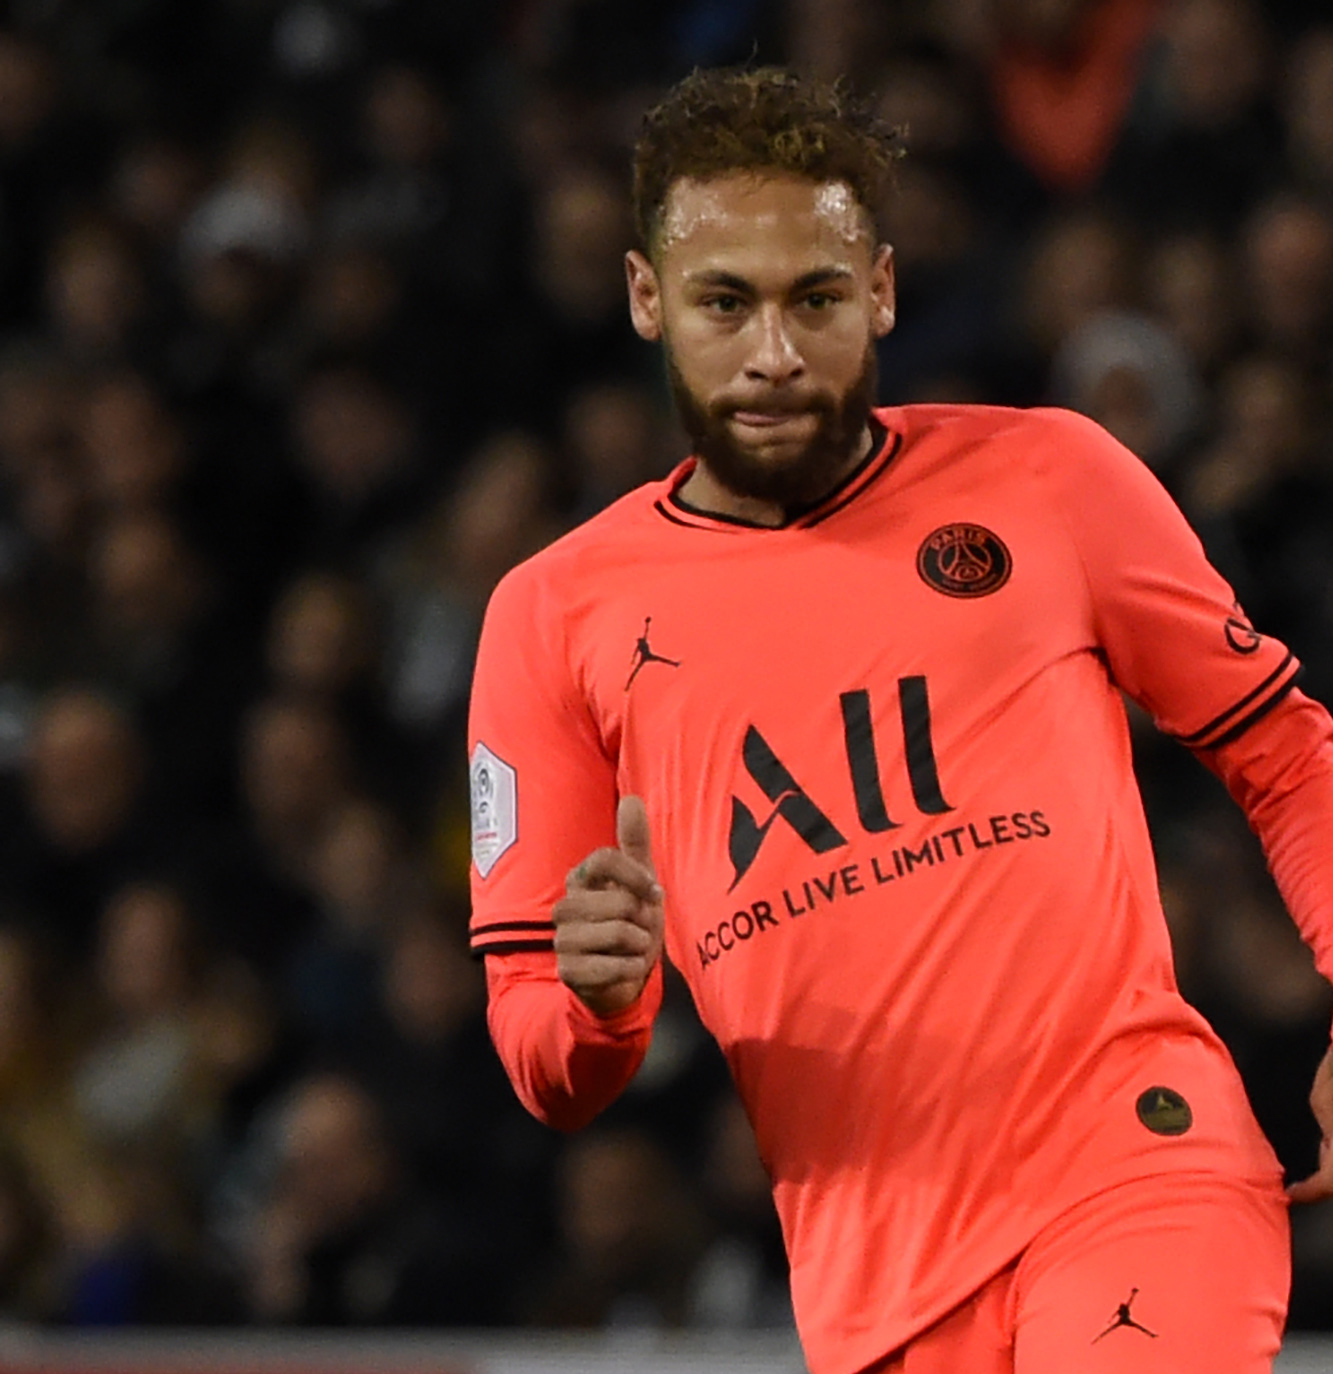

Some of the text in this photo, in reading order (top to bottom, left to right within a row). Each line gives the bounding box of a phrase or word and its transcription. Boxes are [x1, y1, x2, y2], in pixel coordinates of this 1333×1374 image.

[929, 526, 986, 551] PARIS
[696, 810, 1051, 970] ACCOR LIVE LIMITLESS
